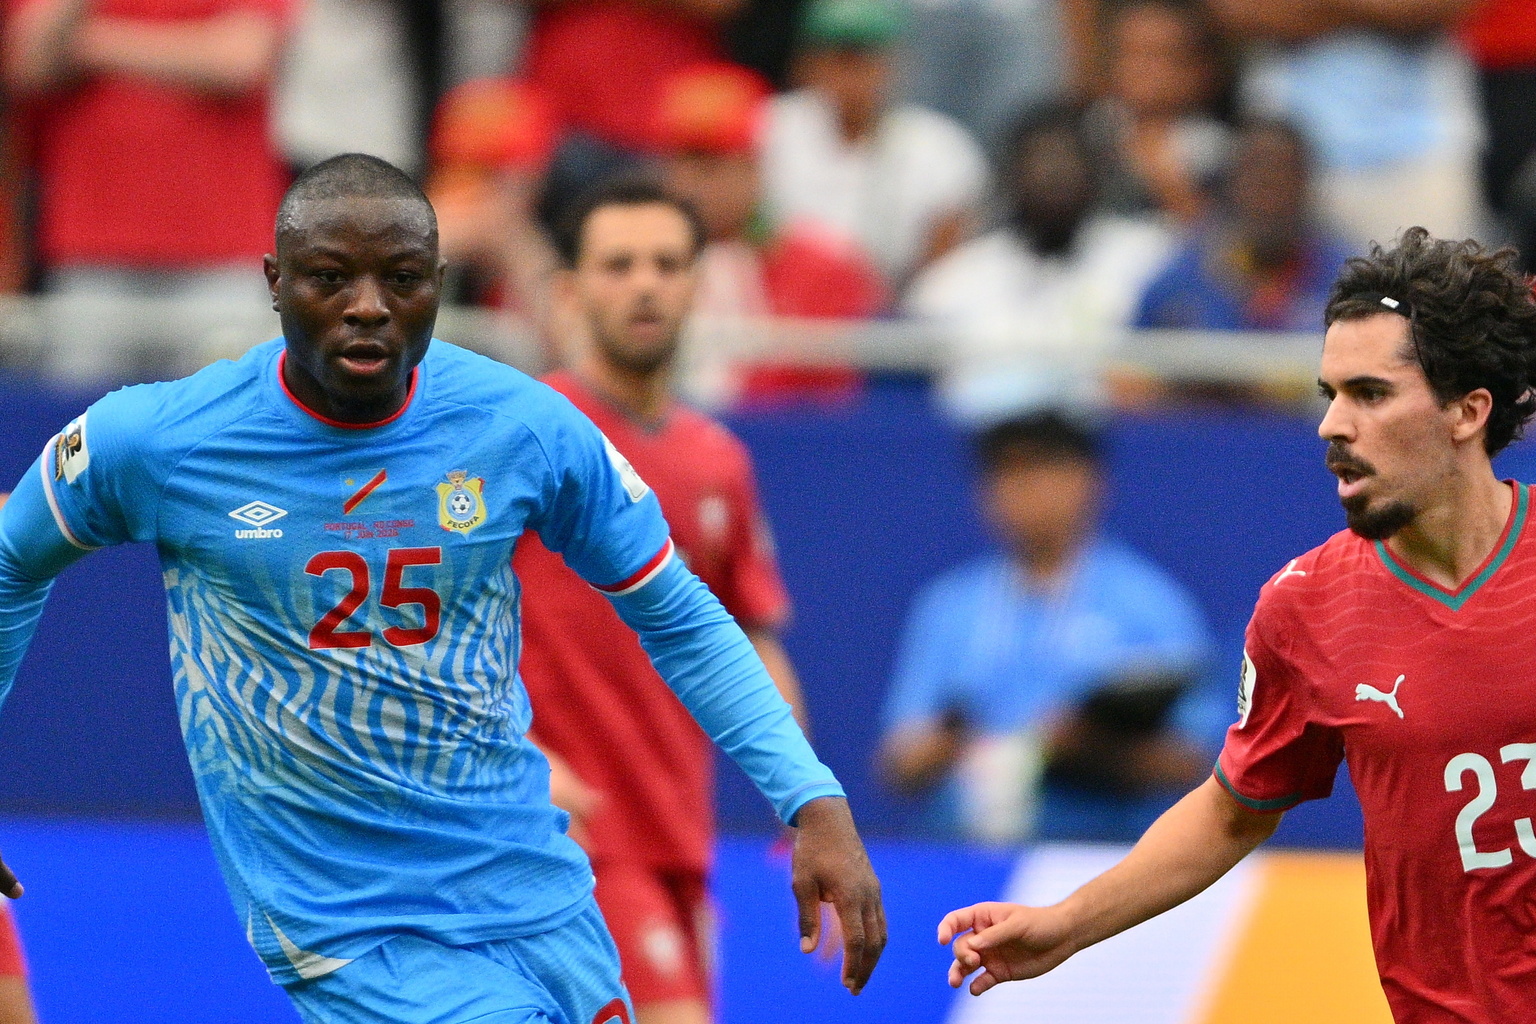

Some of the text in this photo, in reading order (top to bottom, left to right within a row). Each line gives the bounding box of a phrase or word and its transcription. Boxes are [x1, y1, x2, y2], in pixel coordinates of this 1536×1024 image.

[447, 516, 480, 529] FECOFA
[235, 526, 283, 539] umbro
[304, 546, 442, 650] 25
